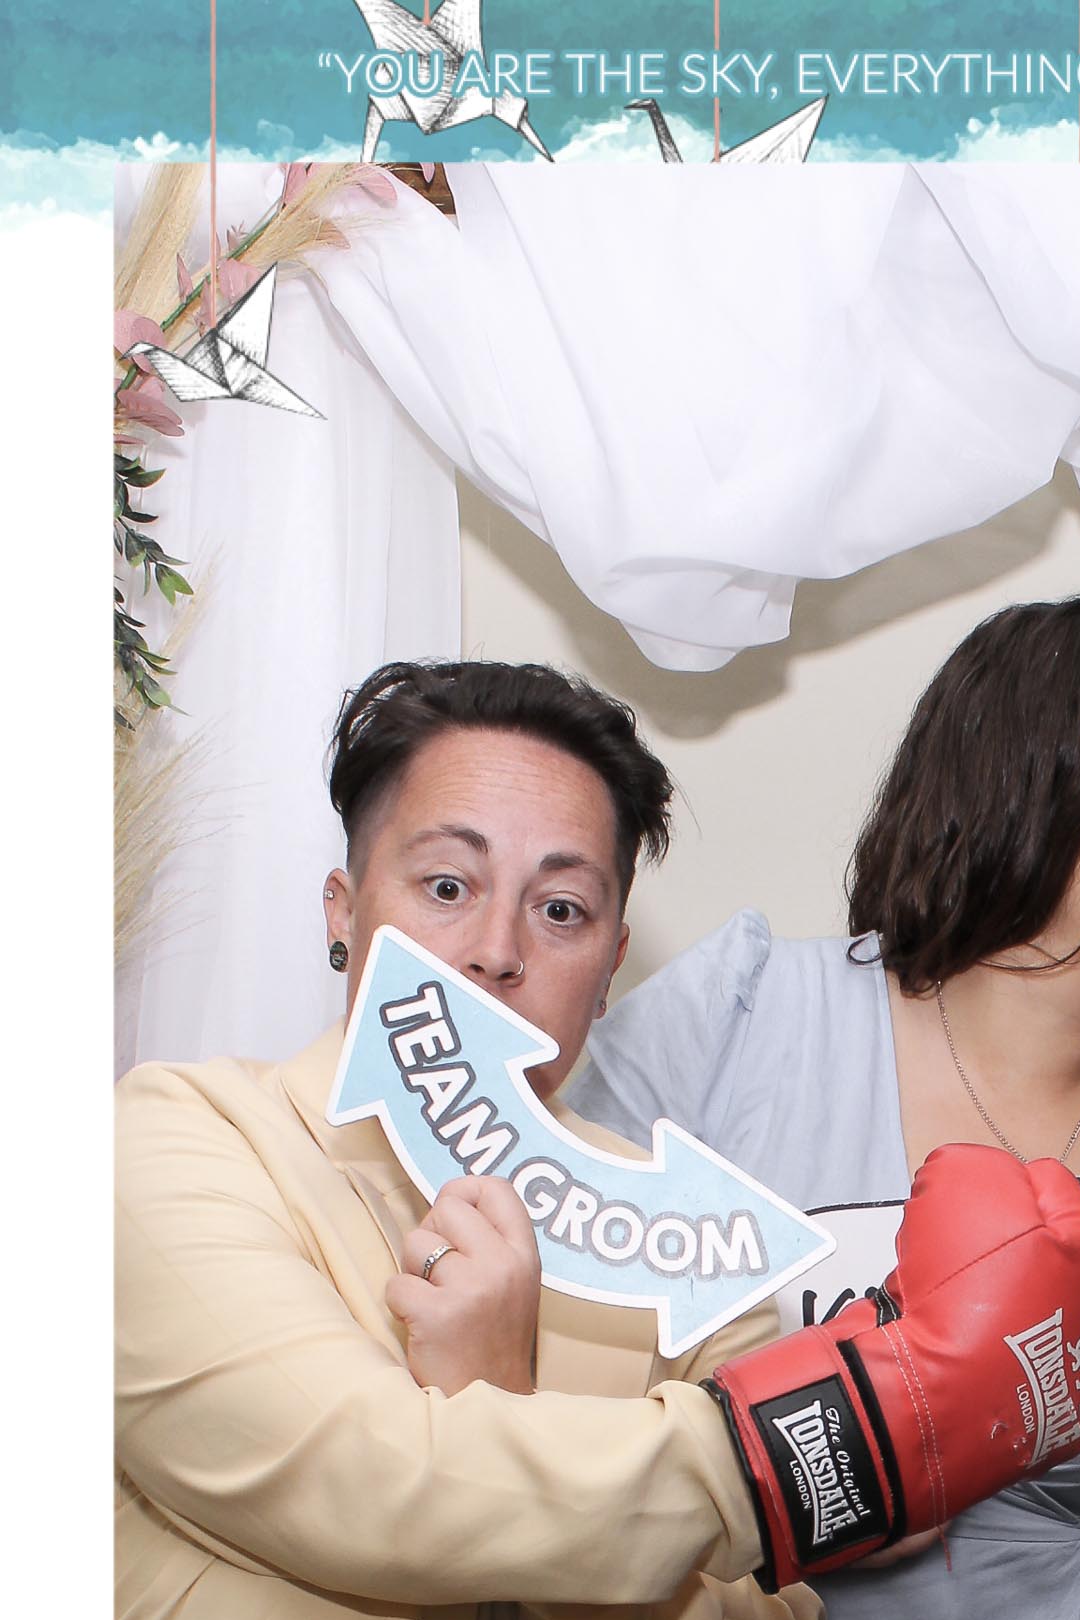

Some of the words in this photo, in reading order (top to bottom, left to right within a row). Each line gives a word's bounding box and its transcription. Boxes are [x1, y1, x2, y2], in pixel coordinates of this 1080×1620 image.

[381, 982, 518, 1176] TEAM
[509, 1157, 768, 1281] GROOM
[825, 1407, 841, 1445] The
[836, 1450, 871, 1517] Original
[1016, 1383, 1036, 1434] LONDON
[772, 1400, 858, 1545] LONSDALE
[789, 1460, 813, 1510] LONDON
